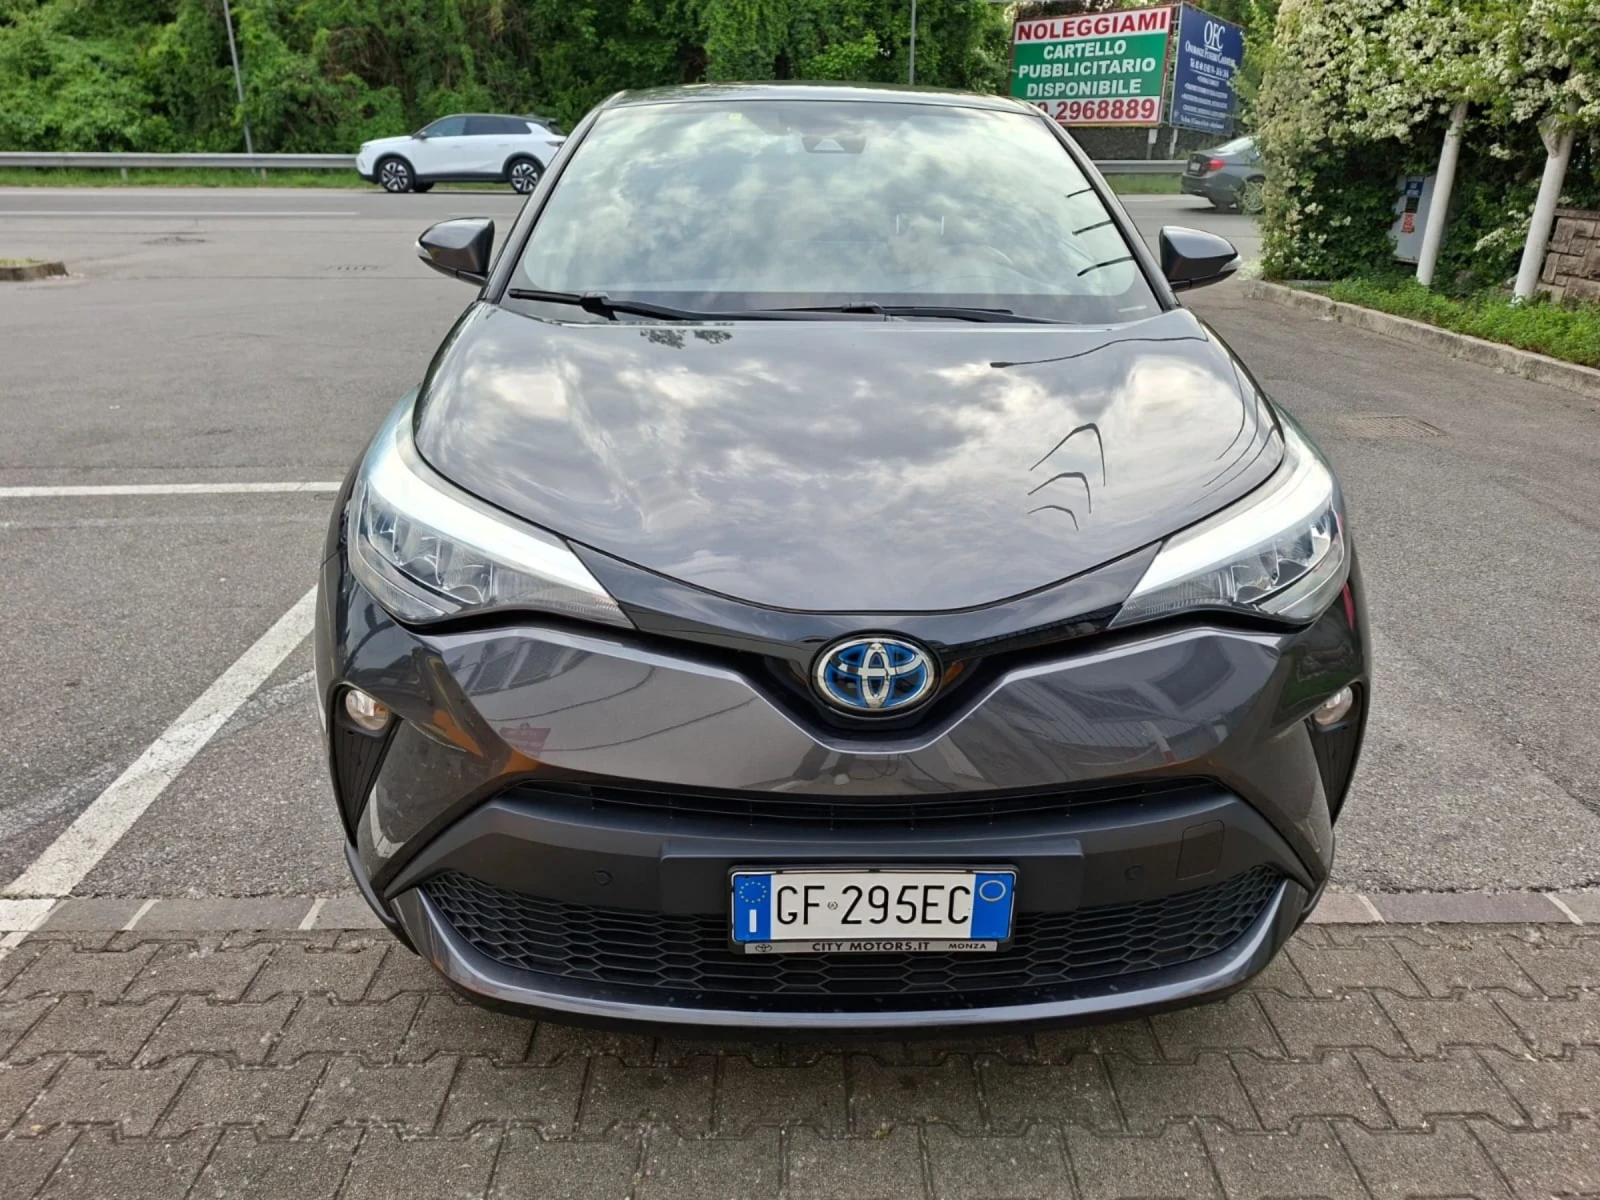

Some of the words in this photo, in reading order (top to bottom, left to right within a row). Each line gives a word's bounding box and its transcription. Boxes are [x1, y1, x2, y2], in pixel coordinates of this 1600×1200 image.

[1018, 11, 1167, 41] NOLEGGIAMI
[1204, 20, 1226, 50] OFC
[1043, 39, 1127, 60] CARTELLO
[1018, 57, 1156, 79] PUBBLICITARIO
[1026, 78, 1142, 97] DISPONIBILE
[777, 885, 825, 925] GF
[841, 885, 971, 925] 295EC
[812, 942, 844, 952] CITY
[849, 941, 931, 952] MOTORS.IT
[948, 942, 987, 951] MONZA
